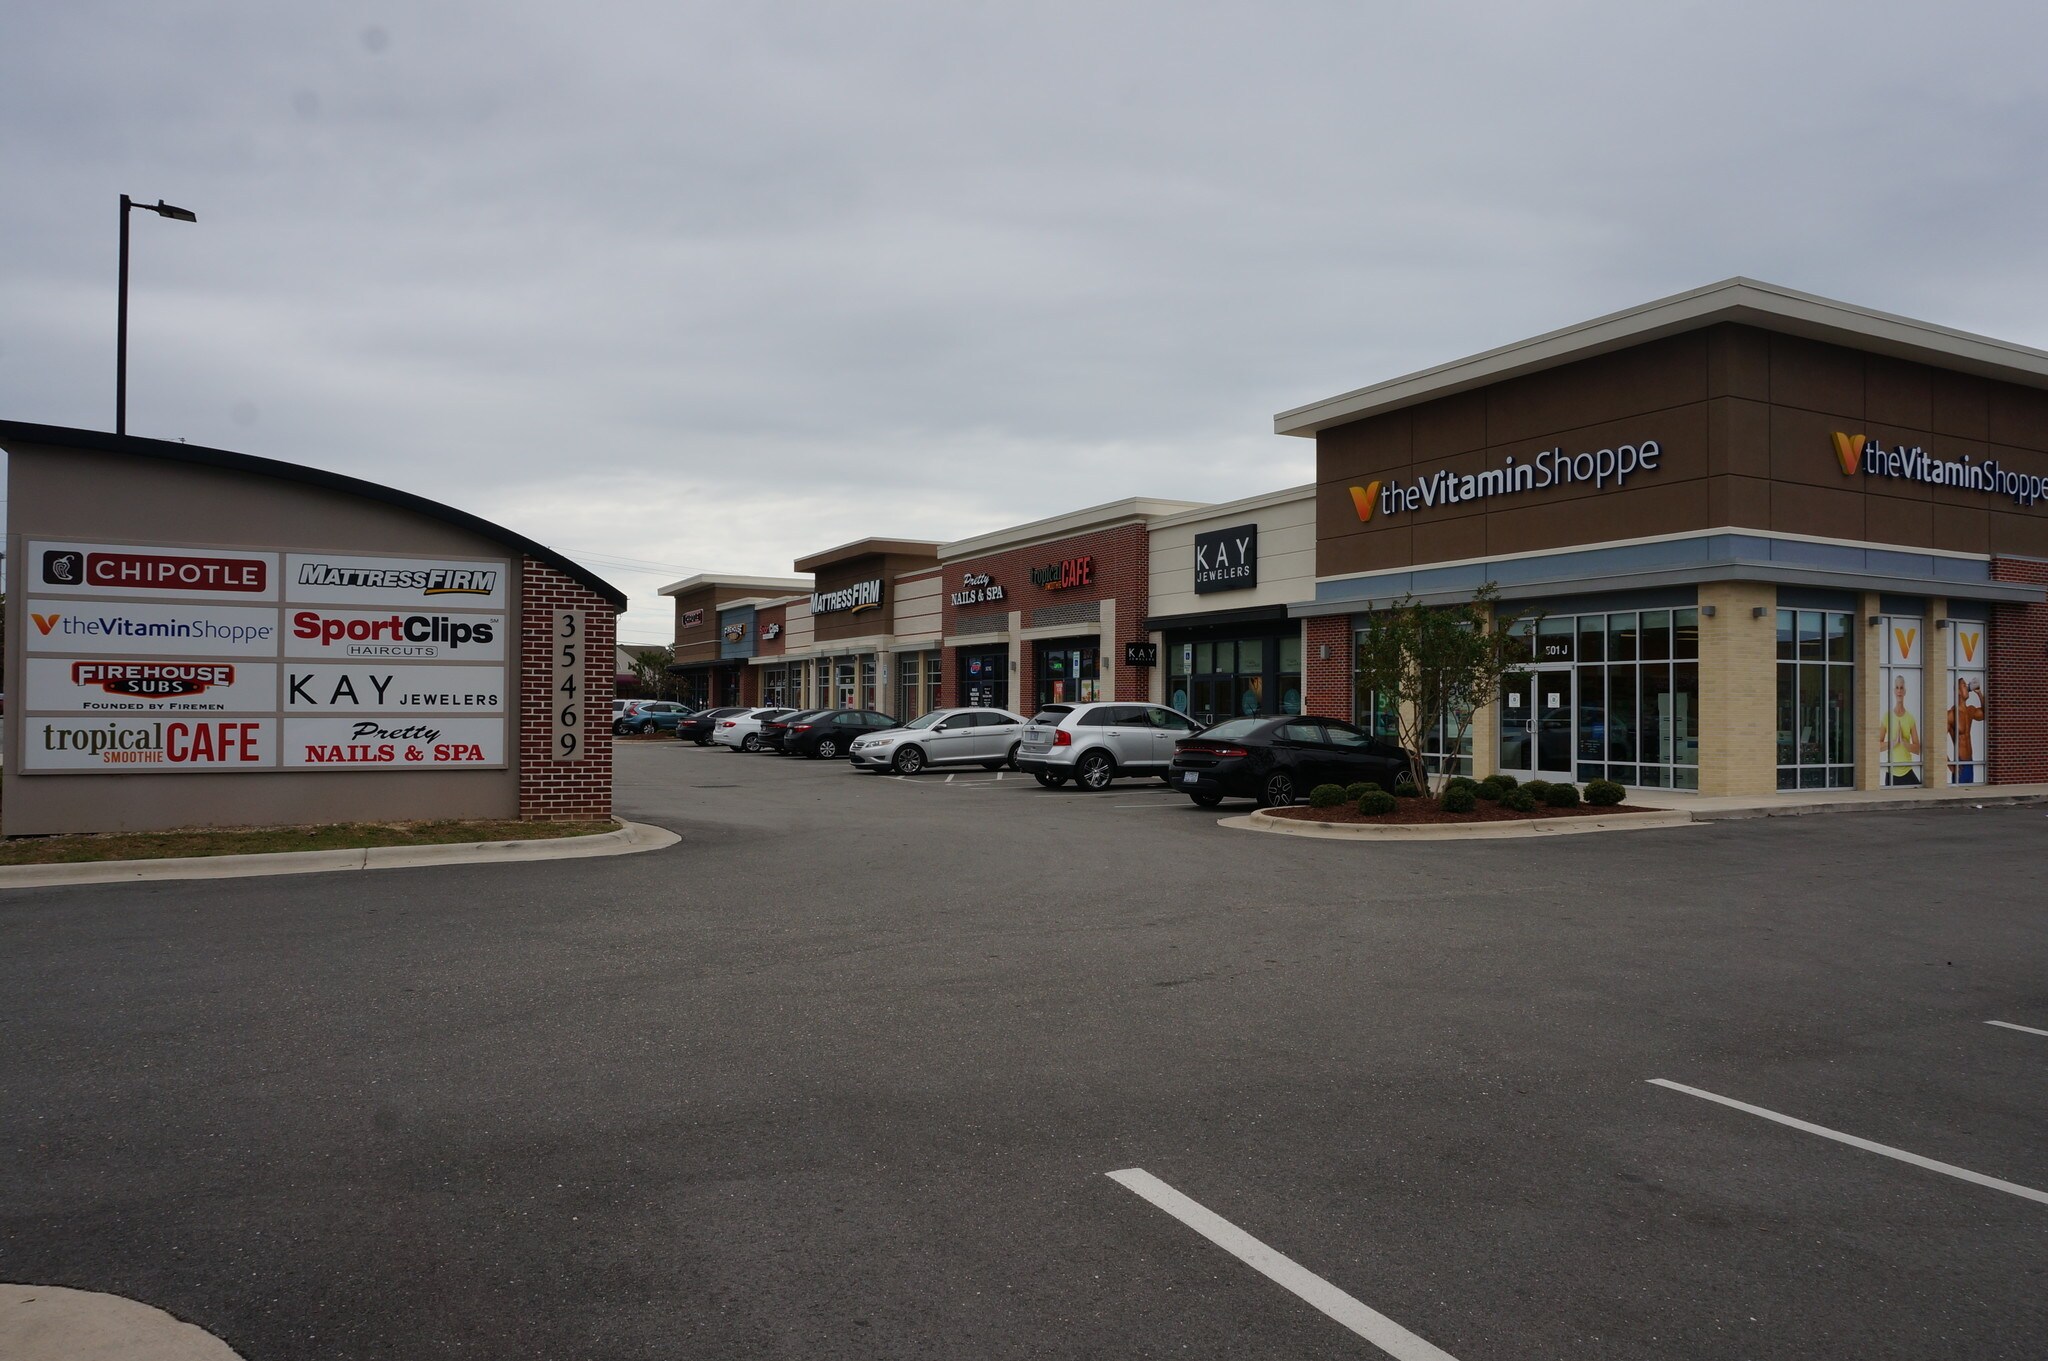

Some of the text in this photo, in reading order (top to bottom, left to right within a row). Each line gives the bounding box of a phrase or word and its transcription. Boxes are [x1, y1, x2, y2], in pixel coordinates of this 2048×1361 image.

[1197, 537, 1249, 571] KAY
[95, 560, 258, 585] CHIPOTLE
[963, 573, 990, 587] Pretty
[1061, 556, 1091, 588] CAFE
[1197, 565, 1250, 583] JEWELERS
[951, 585, 1003, 606] NAILS & SPA
[293, 611, 494, 649] SportClips
[350, 646, 435, 656] HAIRCUTS
[1128, 648, 1155, 658] KAY
[1545, 645, 1568, 656] 501 J
[77, 665, 230, 687] FIREHOUSE
[128, 680, 184, 693] SUBS
[290, 674, 498, 706] KAY JEWELERS
[43, 722, 260, 763] tropical CAFE
[352, 721, 441, 744] Pretty
[103, 751, 163, 763] SMOOTHIE
[305, 744, 485, 762] NAILS & SPA
